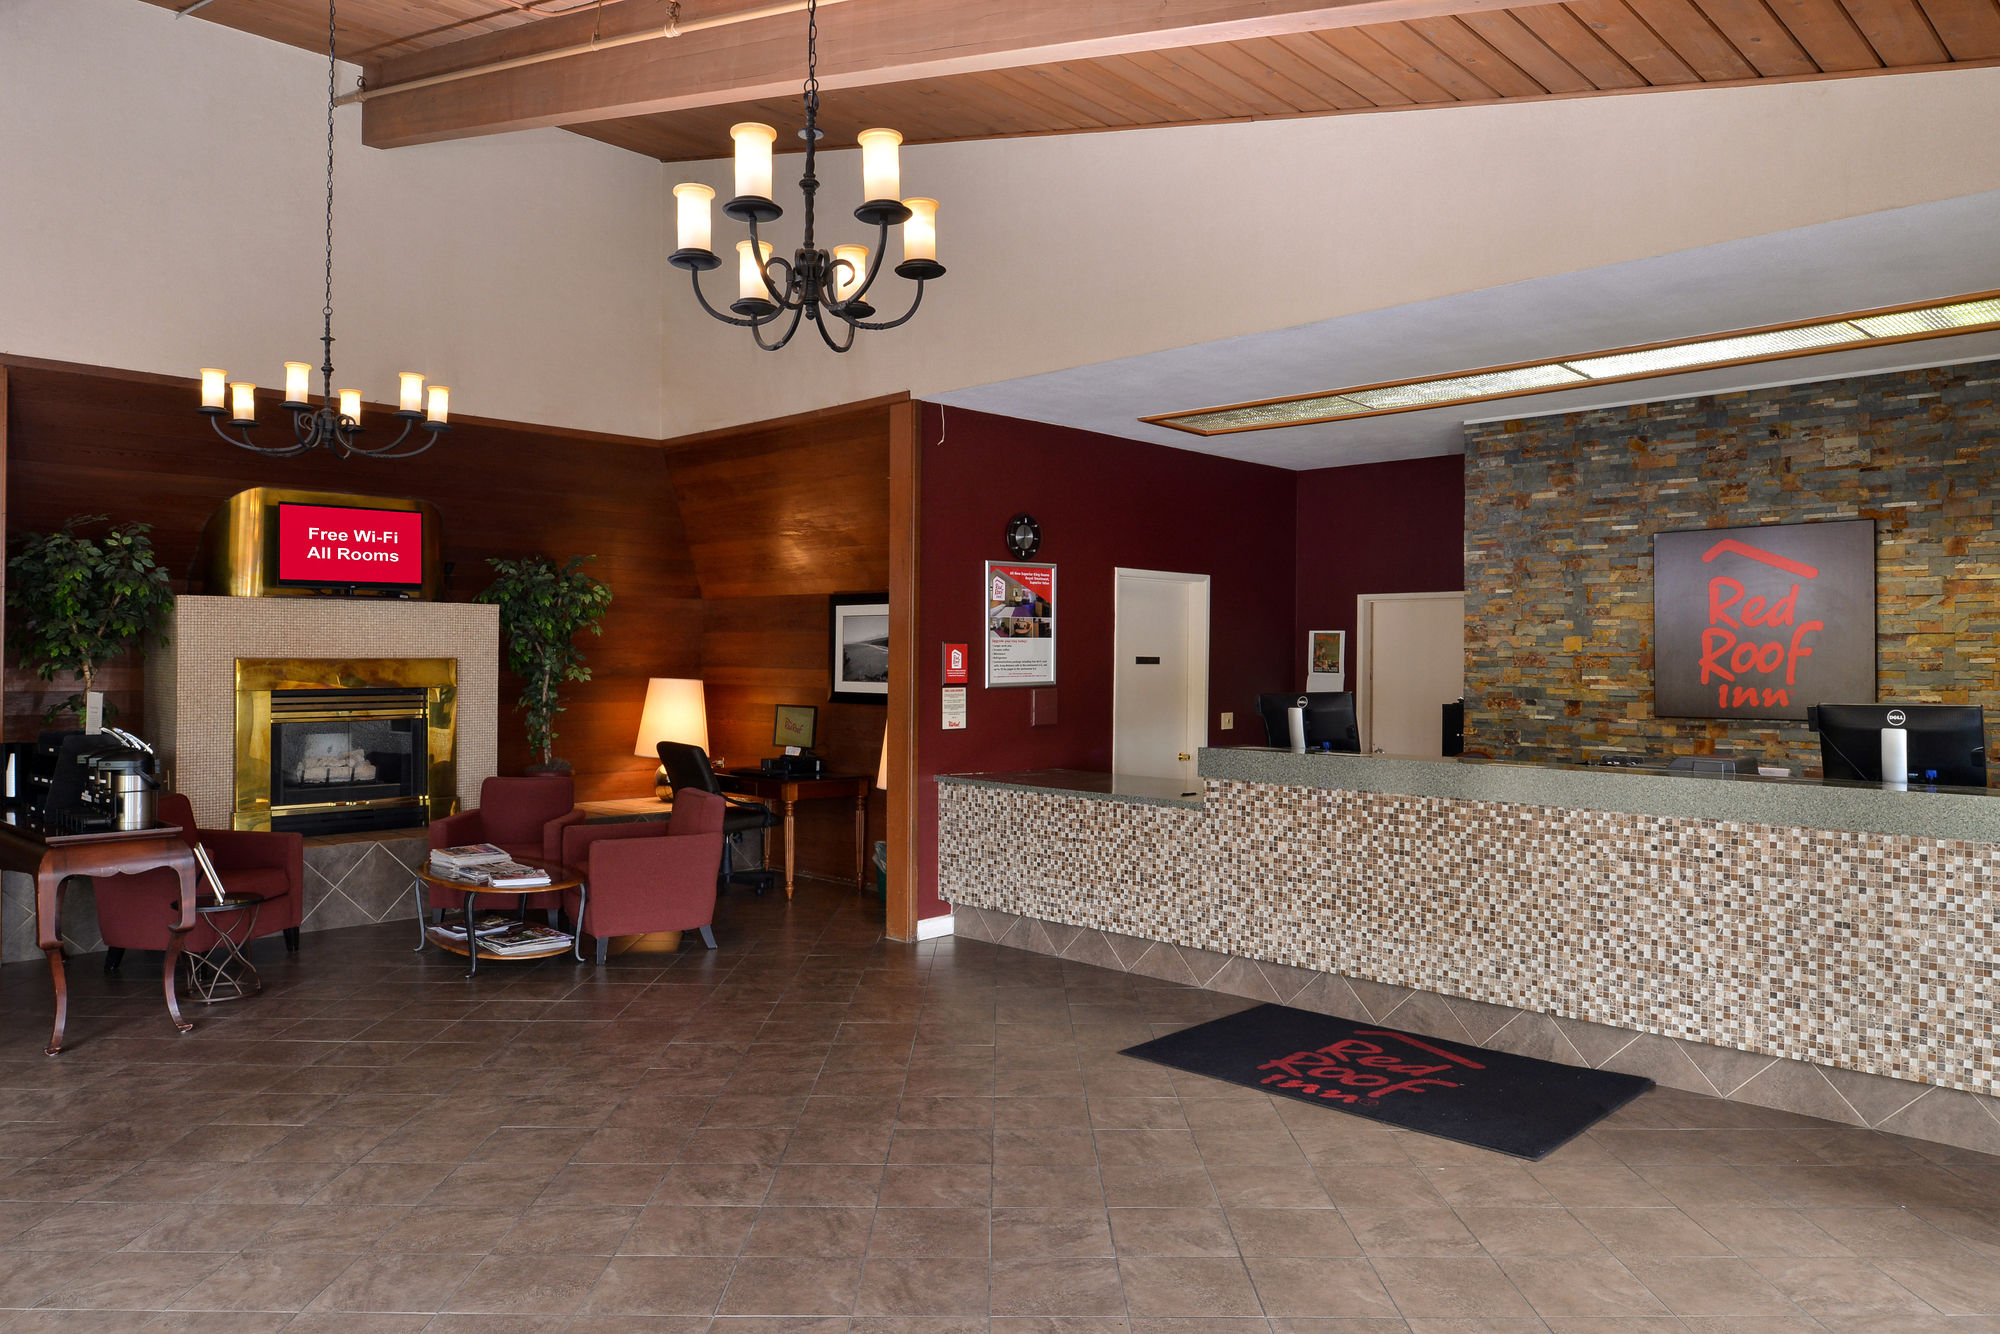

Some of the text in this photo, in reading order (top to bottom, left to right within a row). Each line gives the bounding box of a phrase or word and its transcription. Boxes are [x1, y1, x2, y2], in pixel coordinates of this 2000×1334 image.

[306, 546, 400, 563] All Rooms
[308, 527, 398, 544] Free Wi-Fi
[1708, 576, 1800, 630] Red
[1699, 620, 1824, 685] Roof
[1257, 1051, 1459, 1098] Roof
[1316, 1039, 1453, 1076] Red
